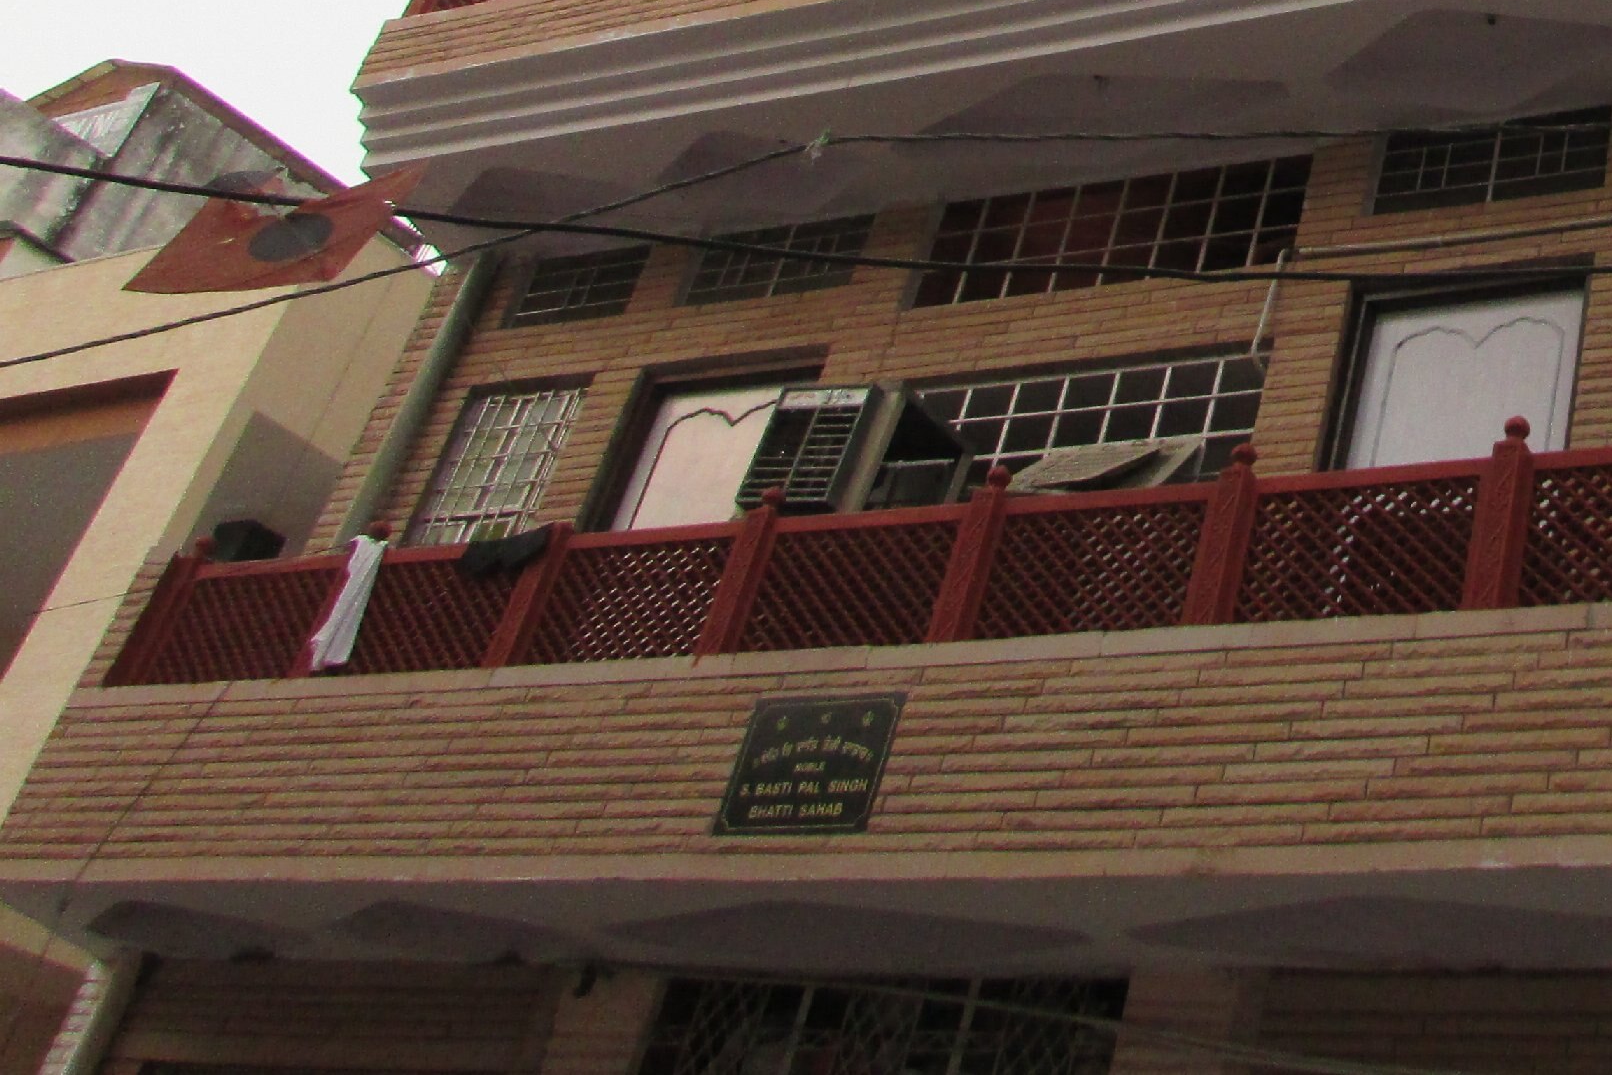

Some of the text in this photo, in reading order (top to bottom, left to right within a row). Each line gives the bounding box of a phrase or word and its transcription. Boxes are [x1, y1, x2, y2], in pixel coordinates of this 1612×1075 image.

[755, 781, 793, 795] BASTI
[797, 781, 821, 794] PAL
[827, 779, 869, 794] SINGH
[748, 802, 844, 819] BHATTI SAHAB
